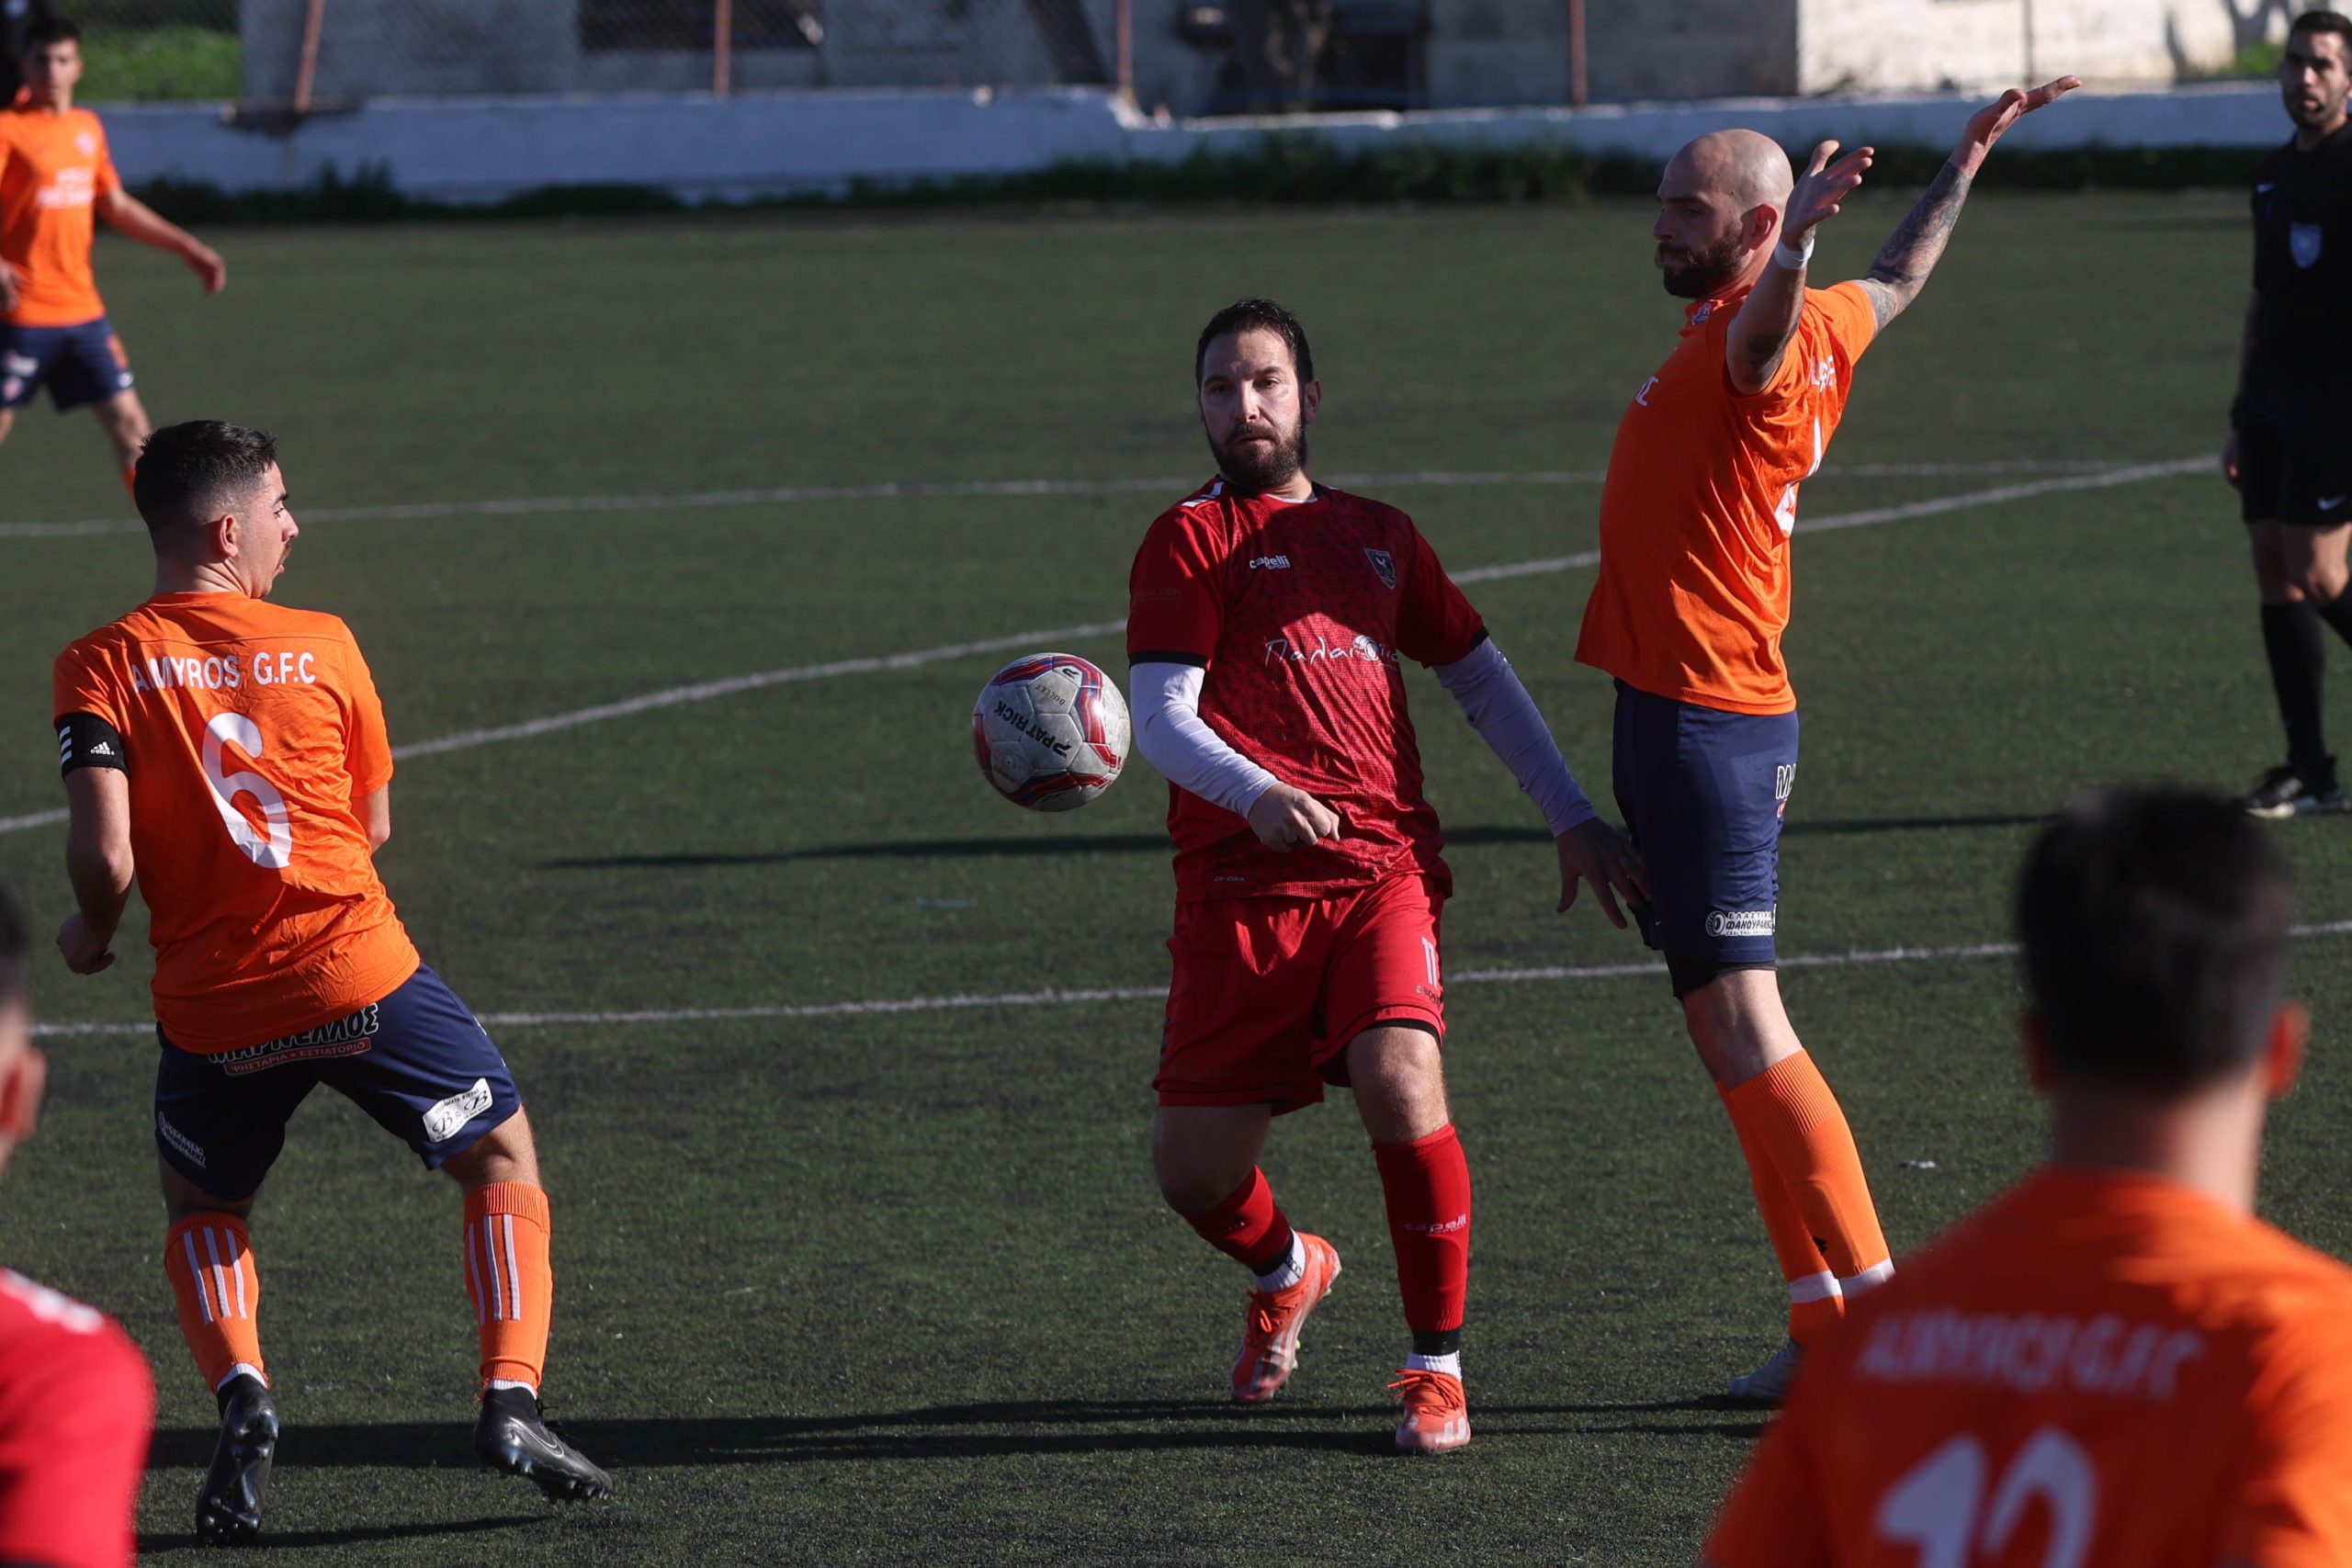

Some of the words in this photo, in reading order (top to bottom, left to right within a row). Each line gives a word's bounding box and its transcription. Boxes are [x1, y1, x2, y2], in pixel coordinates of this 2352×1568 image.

[1034, 683, 1067, 706] BULLET
[201, 711, 293, 870] 6
[230, 1053, 288, 1074] ΨΗΣΤΑΡΙΑ
[299, 1041, 367, 1058] ΕΣΤΙΑΤΟΡΙΟ
